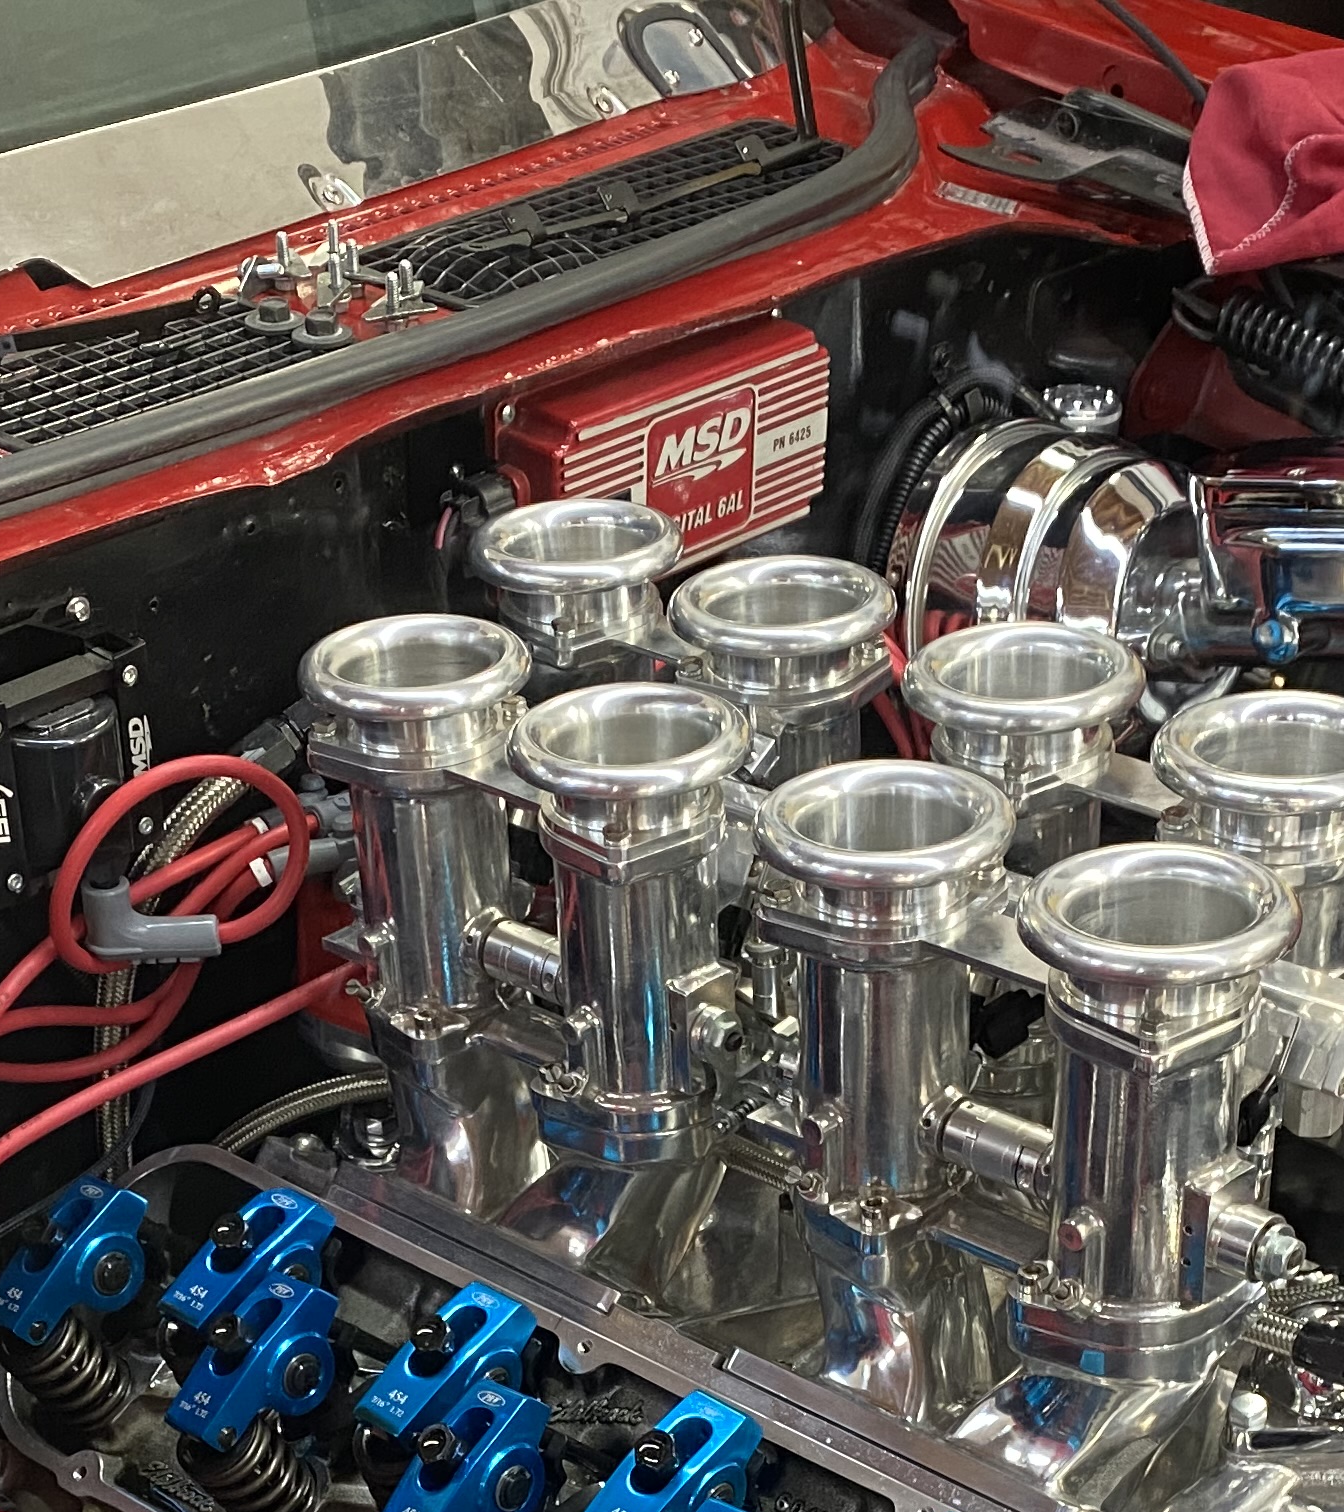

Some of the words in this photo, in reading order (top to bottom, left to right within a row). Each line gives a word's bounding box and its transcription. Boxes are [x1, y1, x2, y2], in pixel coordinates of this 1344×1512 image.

[655, 407, 751, 478] MSD
[772, 437, 786, 452] PN
[789, 426, 812, 446] 6425
[717, 490, 744, 519] 6AL
[128, 716, 149, 778] MSD
[189, 1285, 208, 1299] 454
[193, 1391, 211, 1406] 454
[388, 1389, 408, 1405] 454
